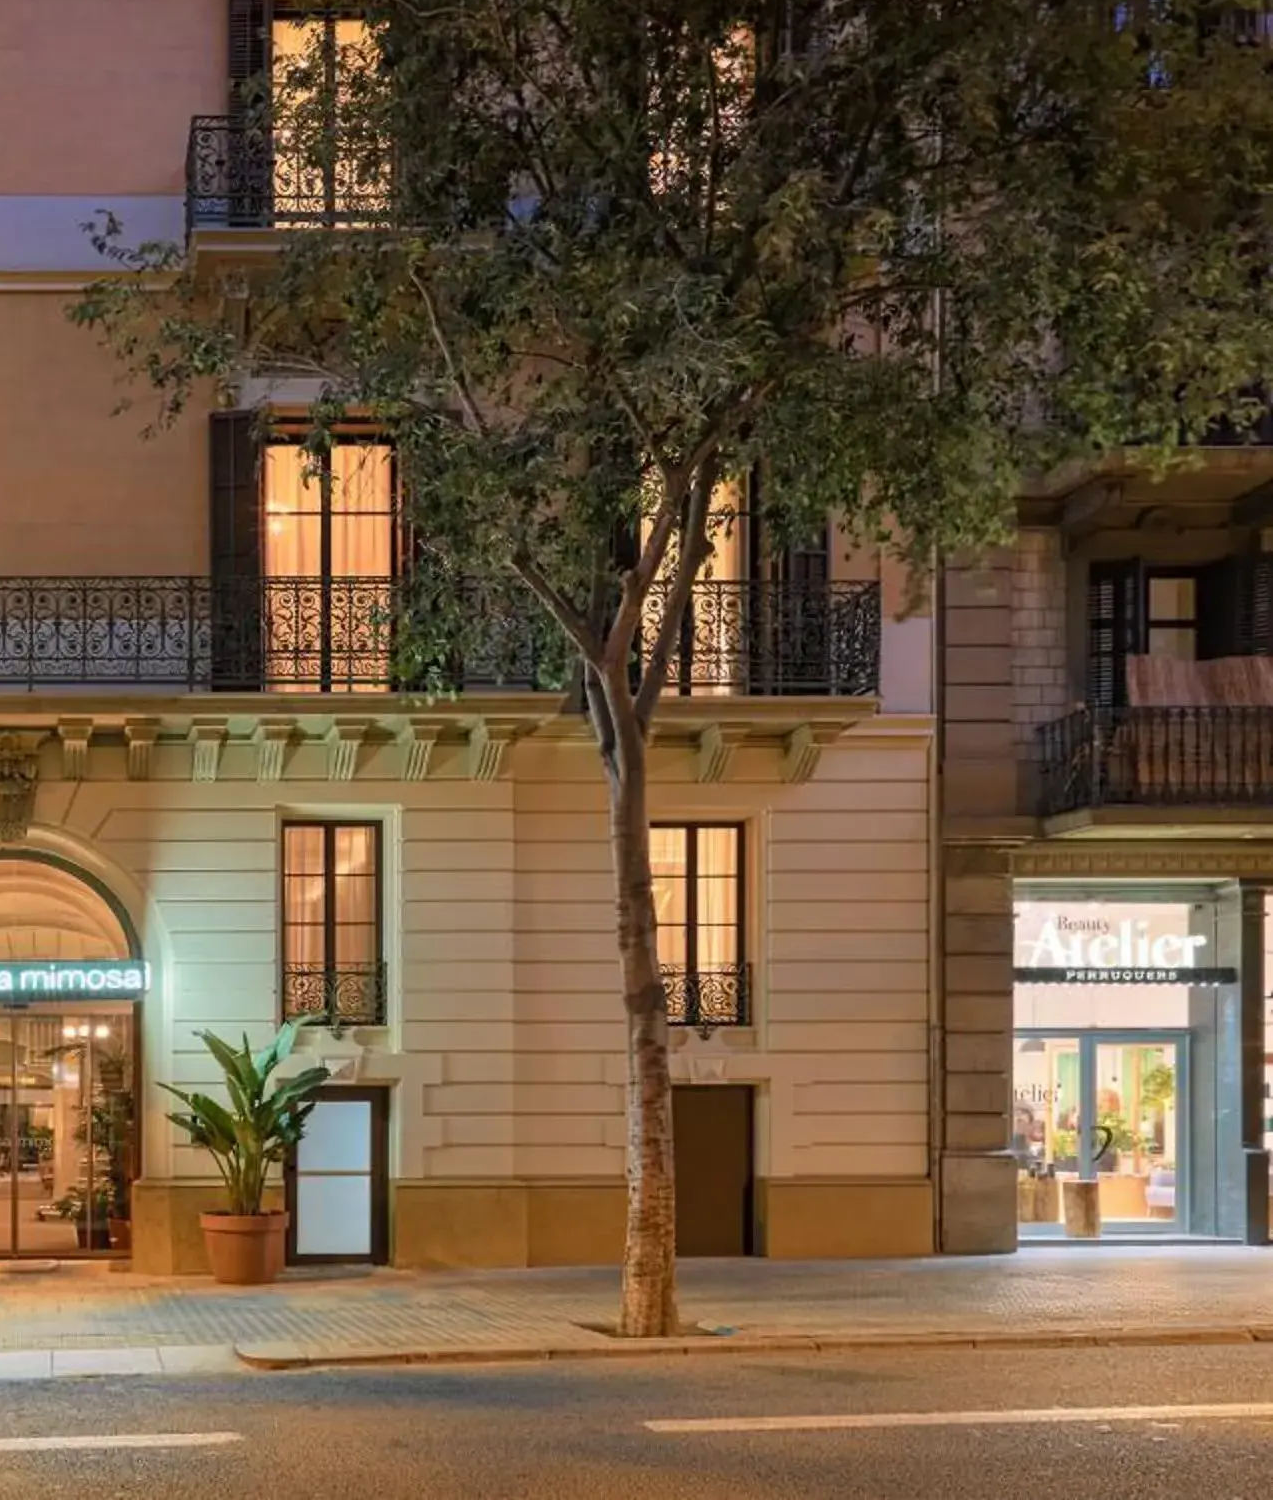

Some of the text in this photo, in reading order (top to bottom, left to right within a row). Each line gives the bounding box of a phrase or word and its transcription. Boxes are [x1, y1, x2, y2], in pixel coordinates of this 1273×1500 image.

[1057, 915, 1111, 934] Beauty
[1020, 913, 1207, 969] Atelier
[20, 964, 142, 990] mimosa
[1065, 970, 1178, 981] PERRUQUERS
